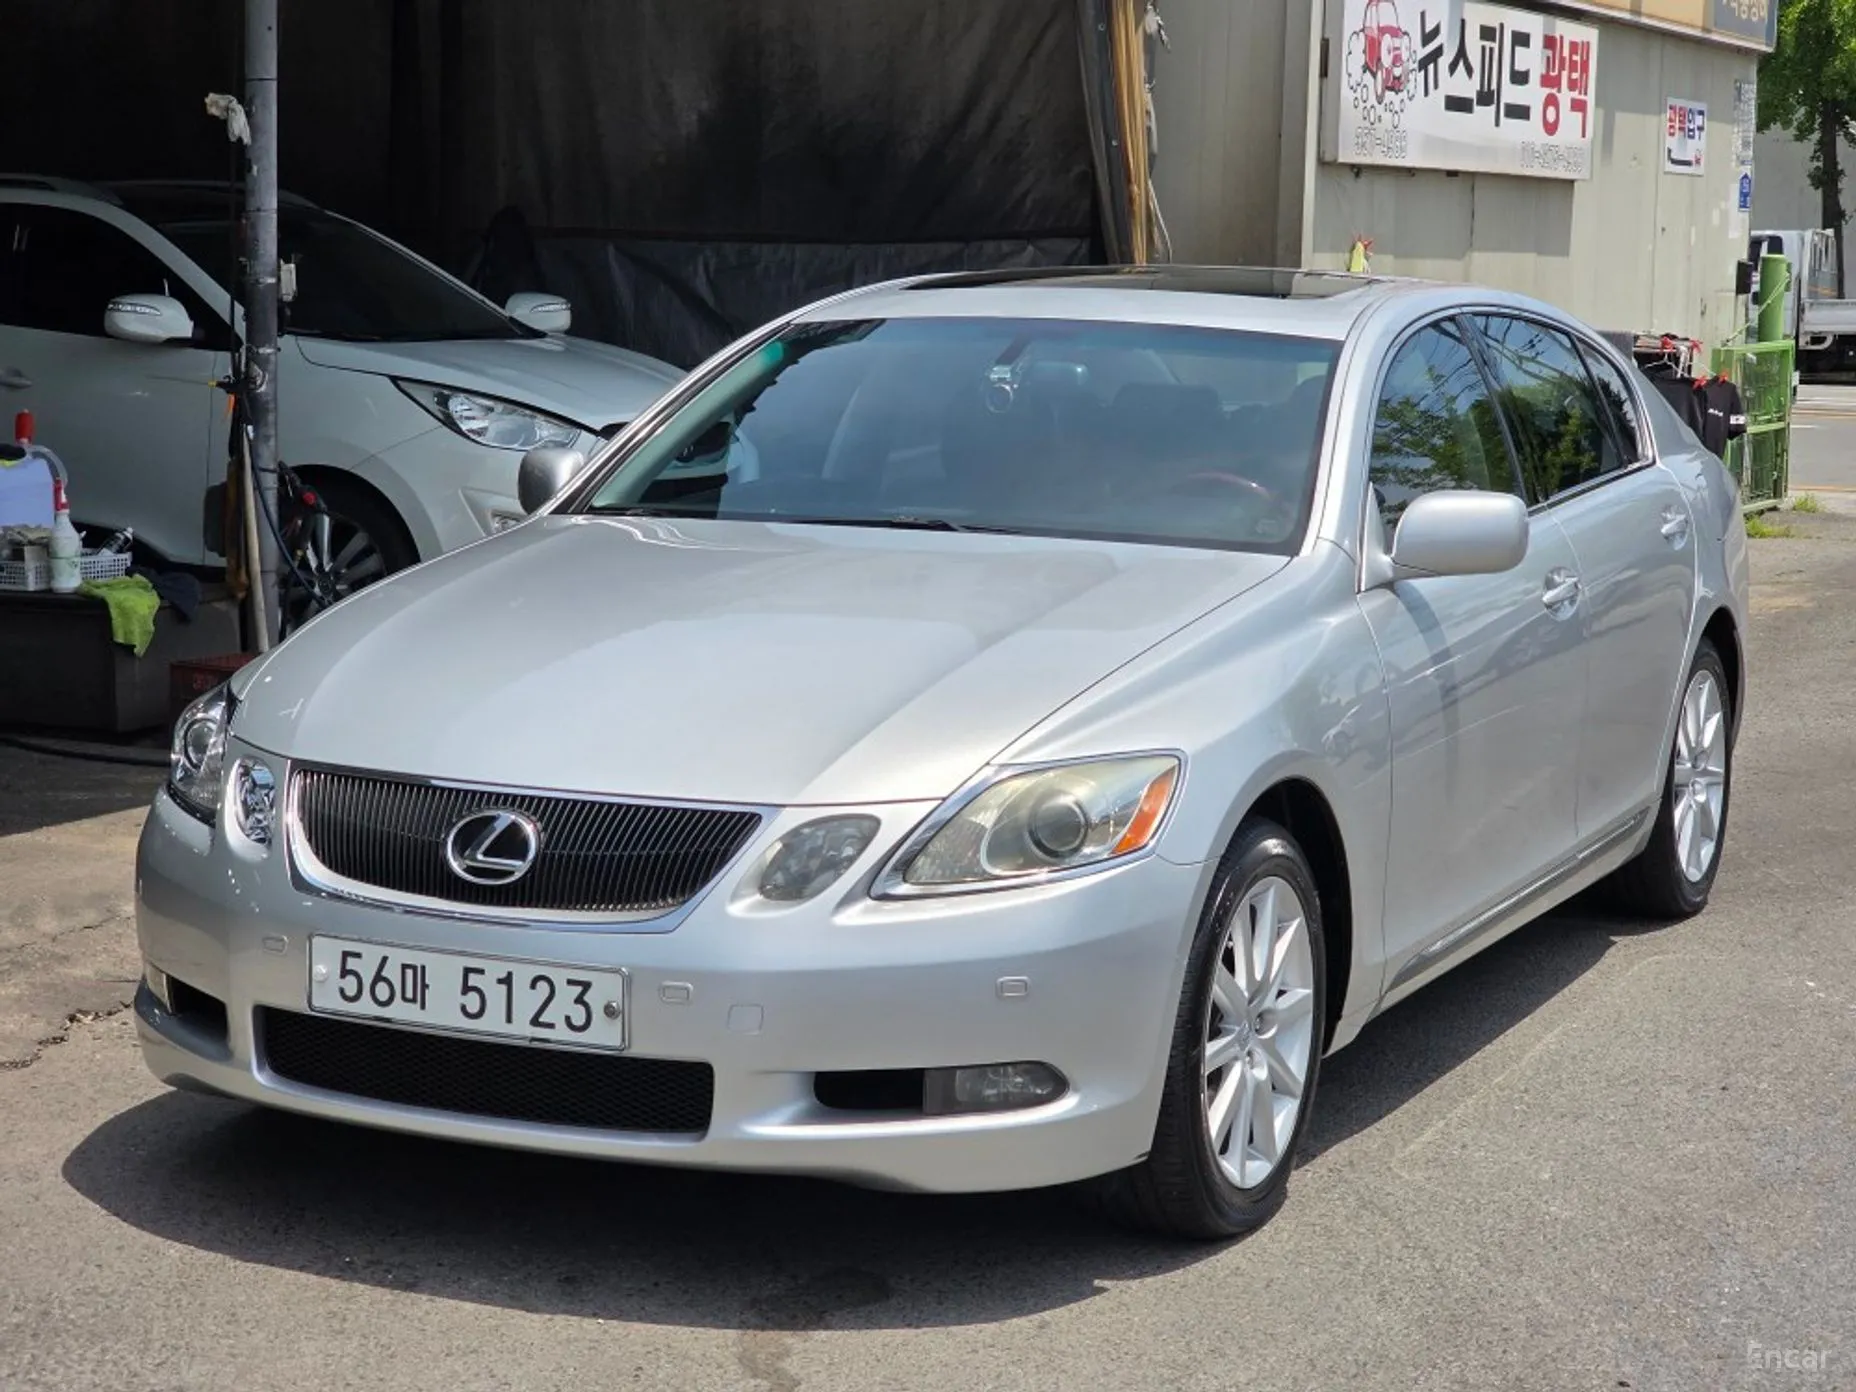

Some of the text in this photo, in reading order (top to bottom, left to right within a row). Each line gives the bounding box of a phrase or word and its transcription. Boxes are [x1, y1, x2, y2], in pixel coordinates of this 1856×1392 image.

[1418, 10, 1591, 138] 뉴스피드 광택
[338, 950, 594, 1033] 56마 5123
